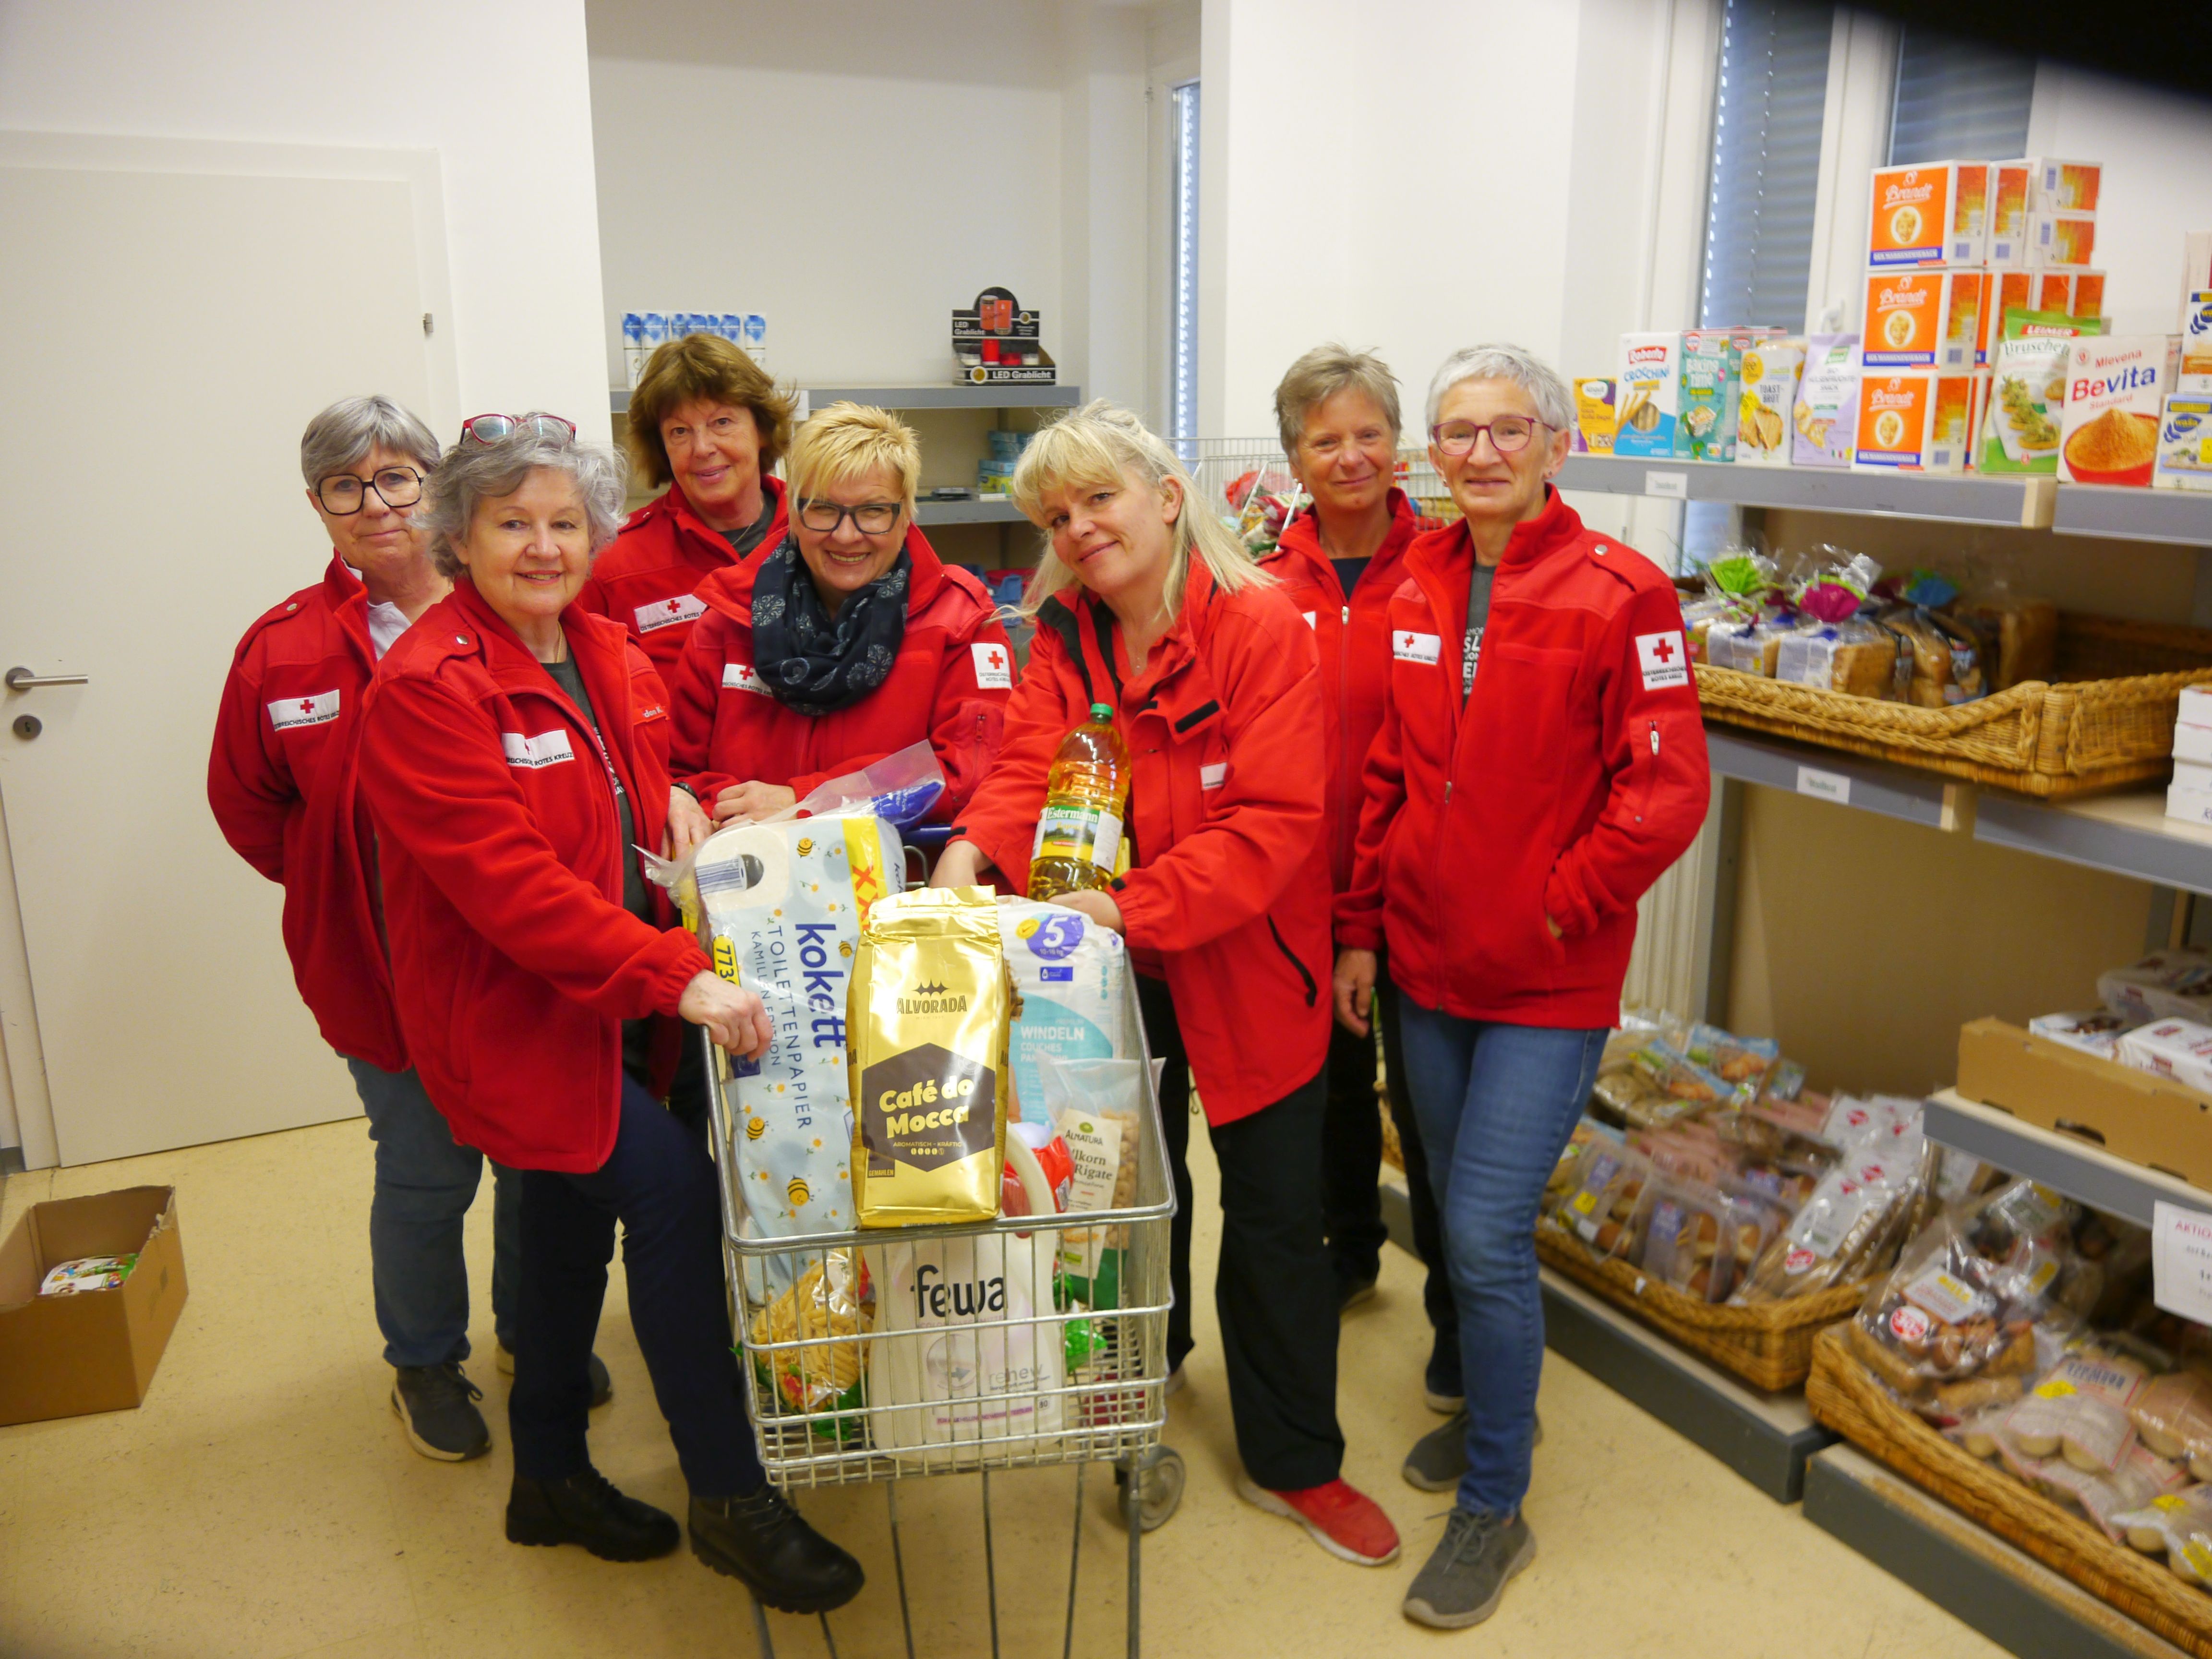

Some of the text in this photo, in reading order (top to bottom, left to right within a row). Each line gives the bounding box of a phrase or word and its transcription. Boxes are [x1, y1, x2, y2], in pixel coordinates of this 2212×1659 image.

[1885, 183, 1933, 203] Brandt
[1879, 288, 1927, 306] Brandt
[1011, 371, 1051, 379] Grablicht
[2072, 366, 2156, 401] Bevita
[1871, 388, 1914, 407] Brandt
[534, 756, 553, 767] ROTES
[554, 752, 573, 760] KREUZ
[1047, 807, 1098, 823] Estermann
[852, 865, 879, 930] XX
[1043, 916, 1069, 948] 5
[751, 931, 771, 999] KAMILLEN
[795, 924, 846, 1048] kokett
[896, 995, 967, 1014] ALVORADA
[767, 925, 812, 1130] TOILETTENPAPIER
[1021, 1025, 1085, 1041] WINDELN
[1021, 1042, 1062, 1052] COUCHES
[879, 1075, 974, 1112] Café do
[886, 1105, 969, 1139] Mocca
[1075, 1164, 1113, 1180] Rigate
[2176, 1220, 2212, 1240] AKTIO
[910, 1264, 1007, 1318] fewa
